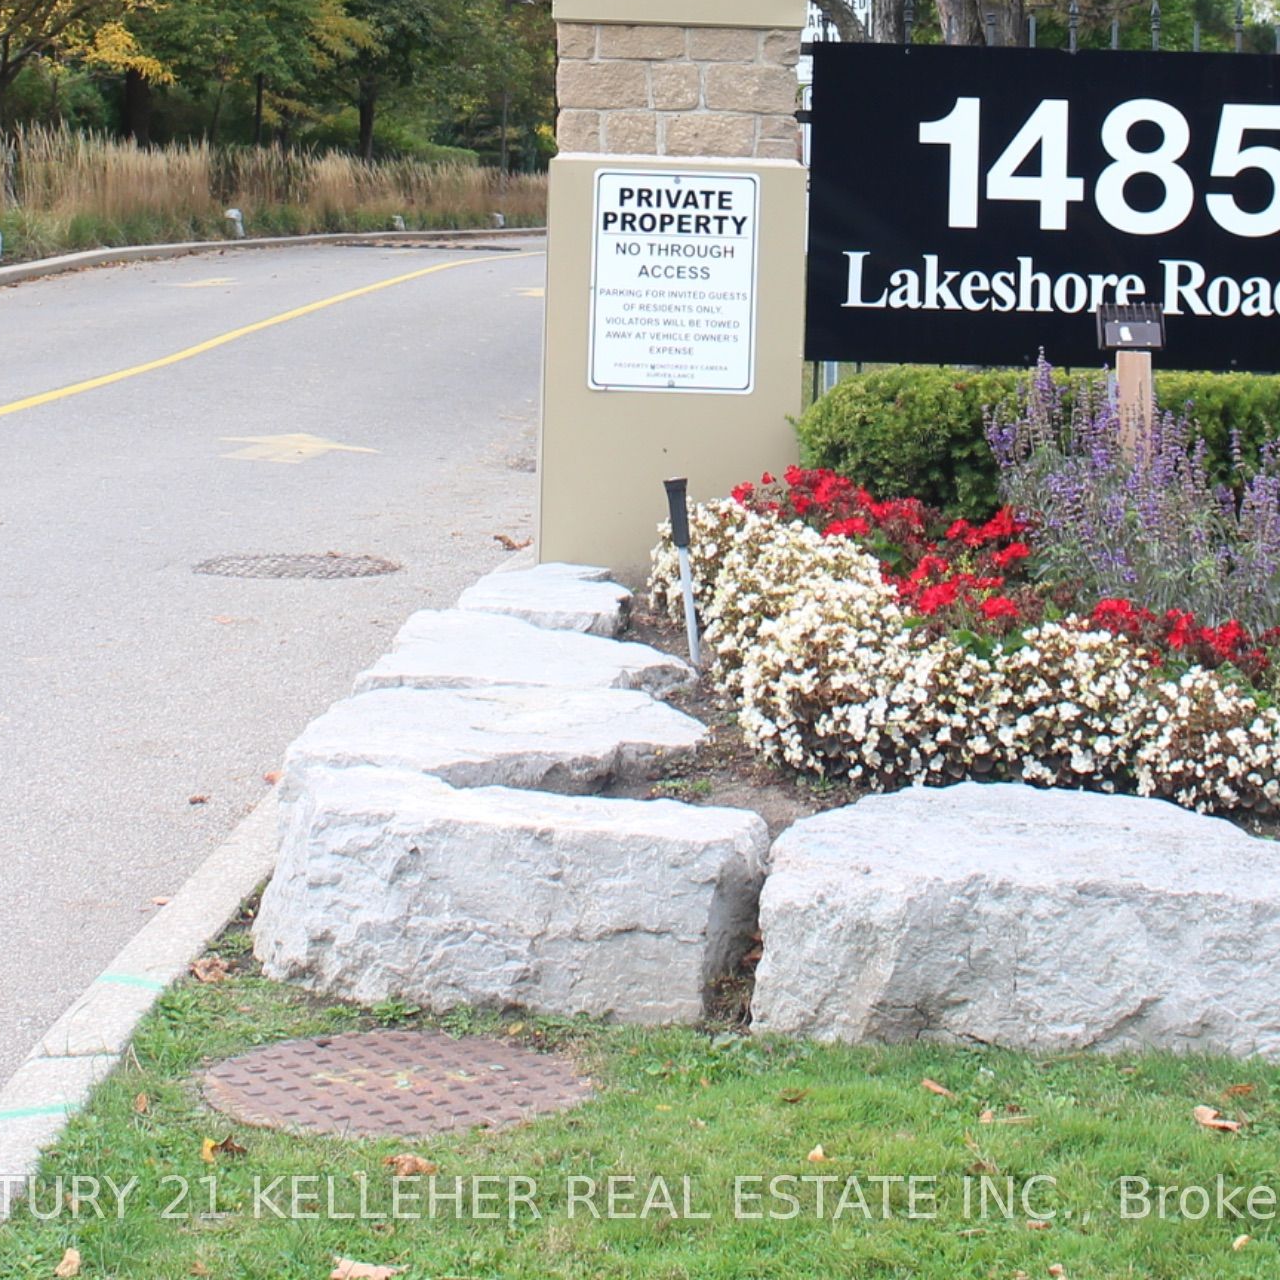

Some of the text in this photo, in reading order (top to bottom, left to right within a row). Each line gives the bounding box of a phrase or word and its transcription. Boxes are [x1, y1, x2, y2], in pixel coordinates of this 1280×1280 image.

[618, 187, 734, 210] PRIVATE
[602, 212, 748, 235] PROPERTY
[615, 242, 734, 258] NO THROUGH
[638, 265, 711, 280] ACCESS
[841, 250, 1146, 314] Lakeshore
[599, 287, 748, 301] PARKING FOR INVITED GUESTS
[623, 303, 636, 311] OF
[639, 303, 693, 313] RESIDENTS
[605, 317, 740, 329] VIOLATORS WILL BE TOWED
[605, 331, 739, 343] AWAY AT VEHICLE OWNER'S
[649, 346, 695, 355] EXPENSE
